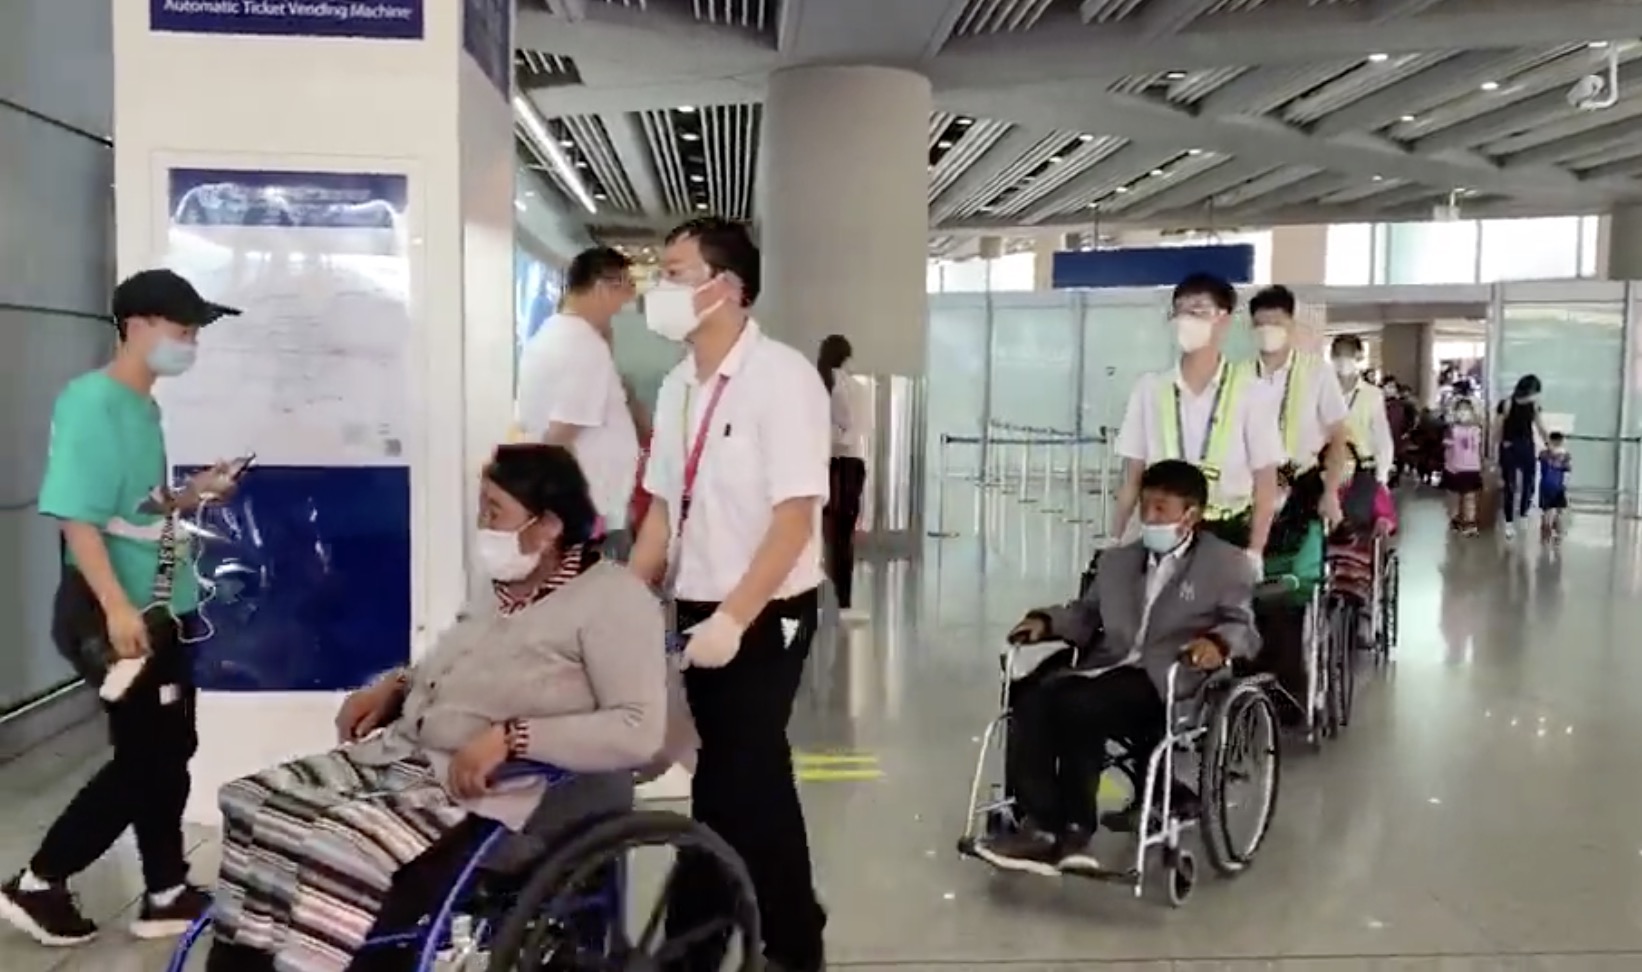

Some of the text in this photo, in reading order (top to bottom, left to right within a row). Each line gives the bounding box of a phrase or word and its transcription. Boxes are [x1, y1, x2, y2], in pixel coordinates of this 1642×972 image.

[163, 0, 412, 19] Automatic Ticket Vending Machine
